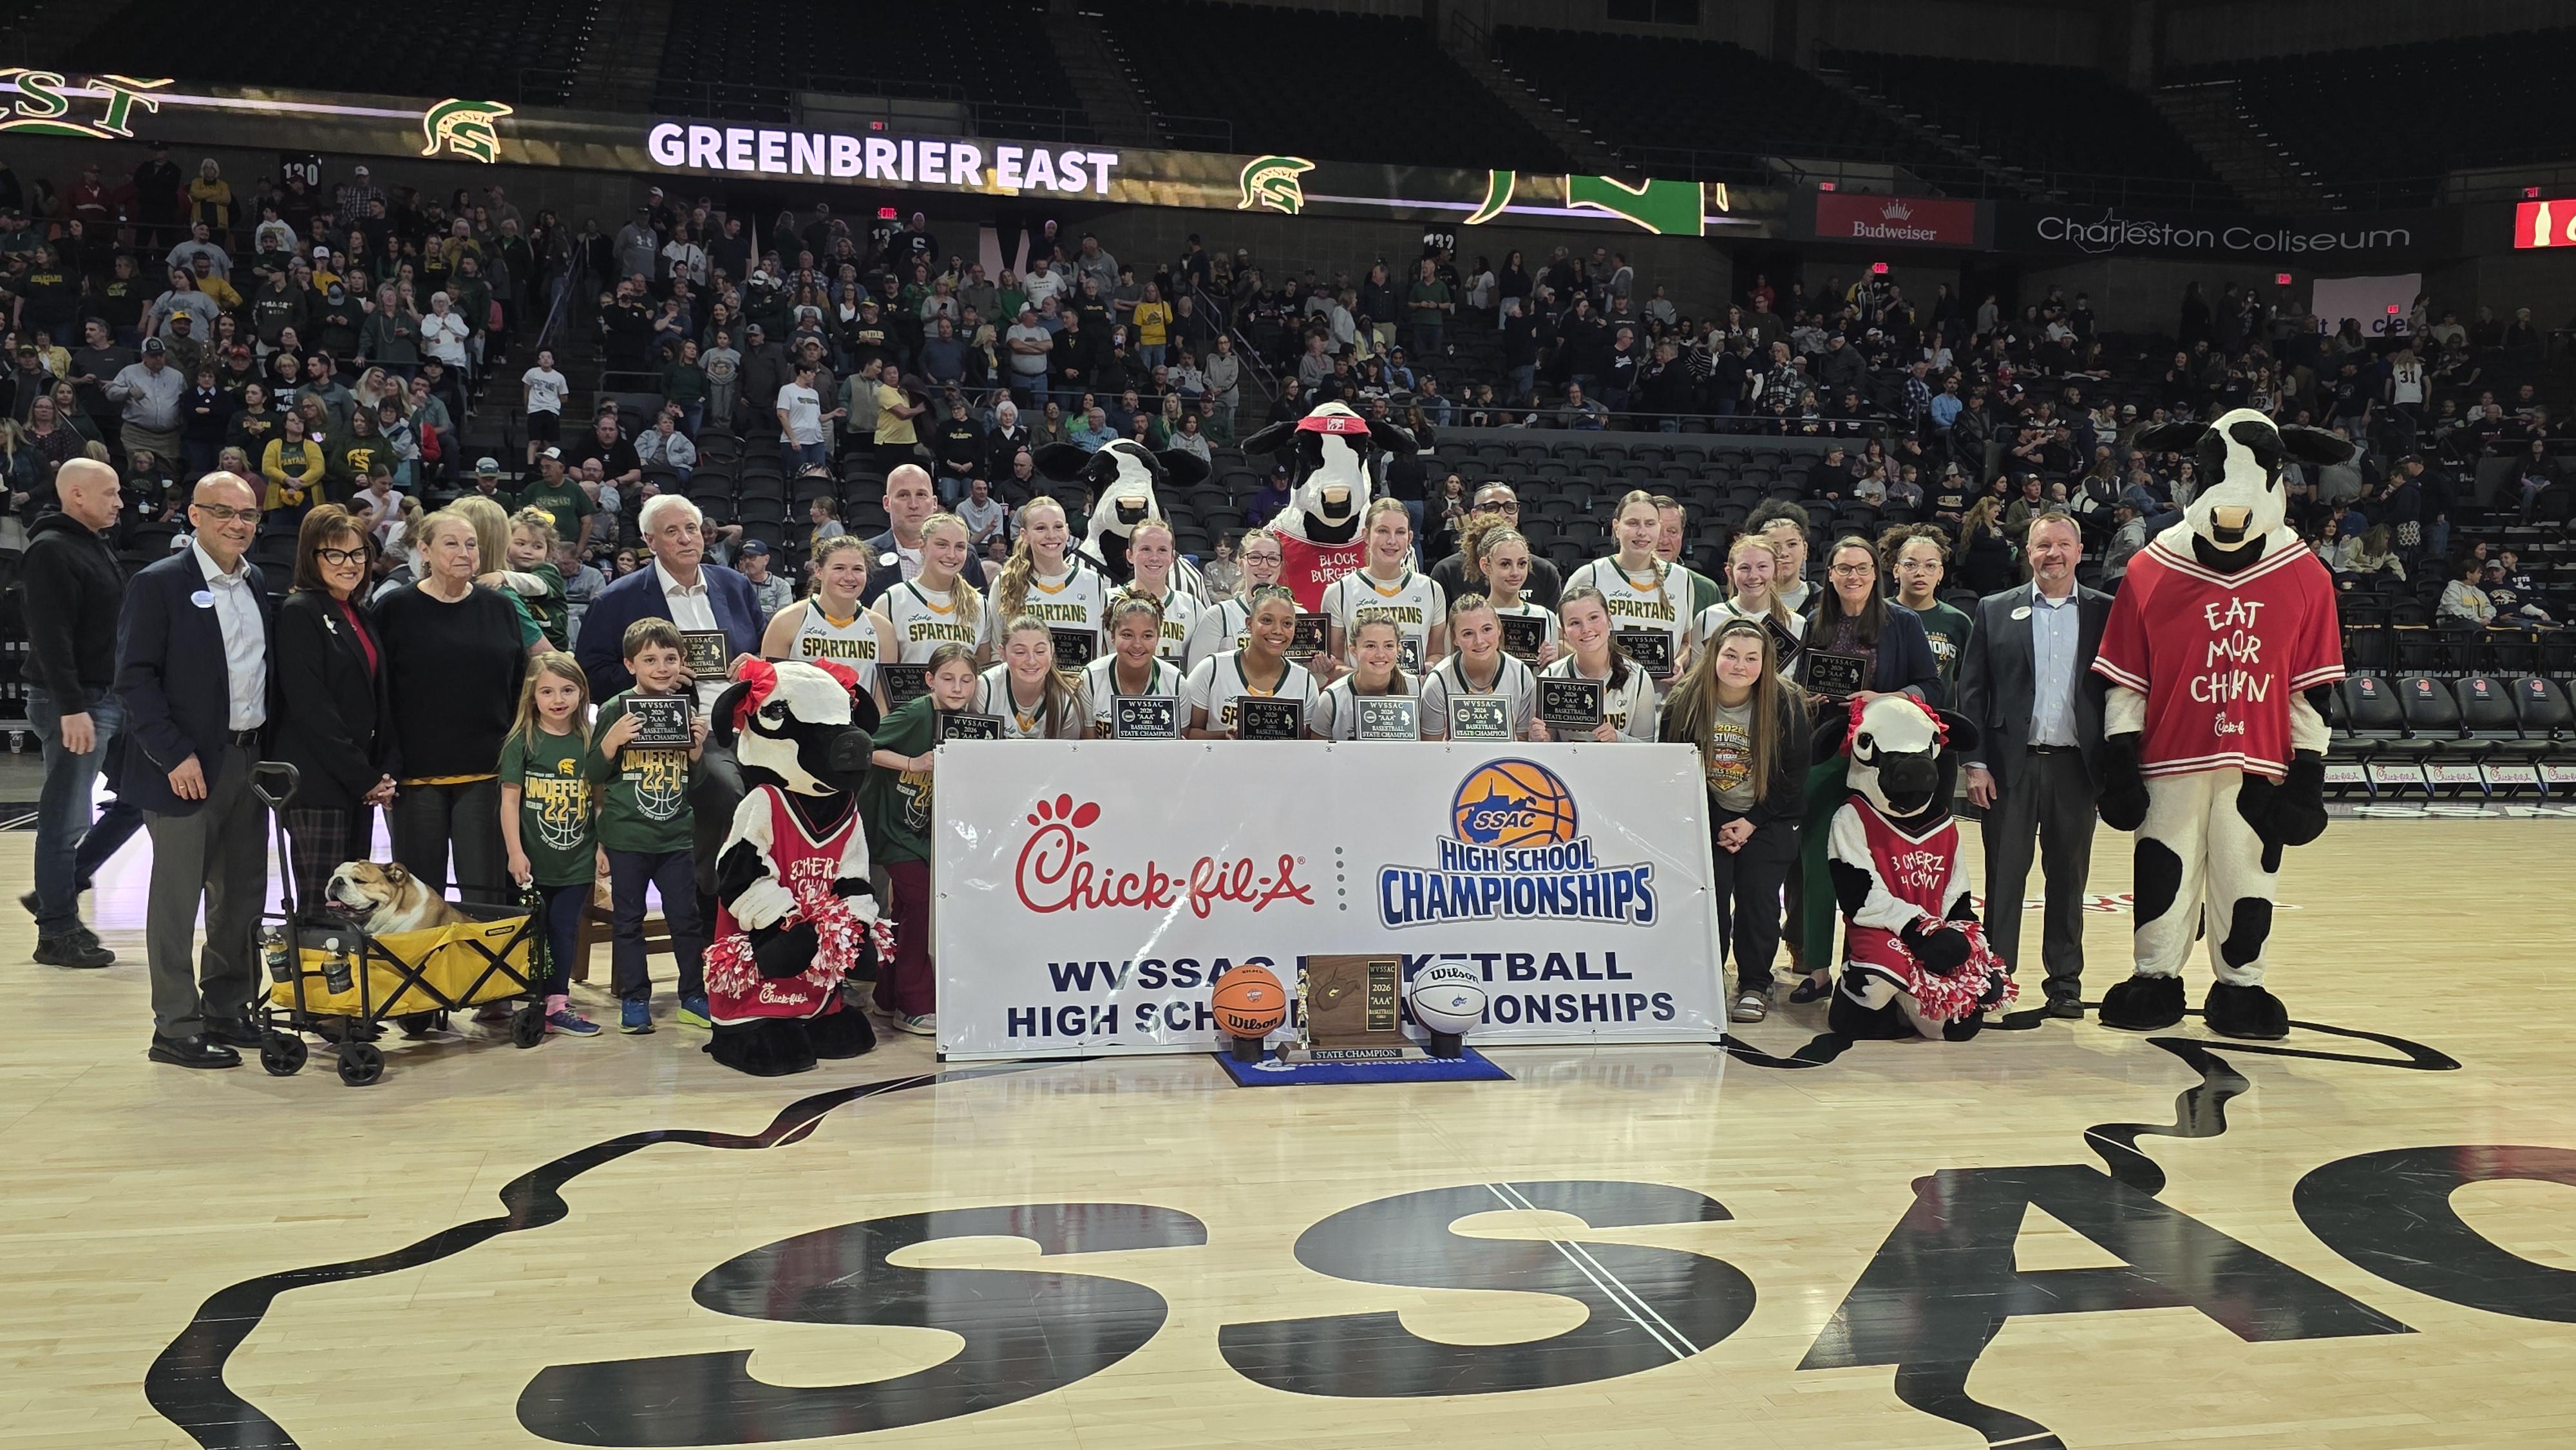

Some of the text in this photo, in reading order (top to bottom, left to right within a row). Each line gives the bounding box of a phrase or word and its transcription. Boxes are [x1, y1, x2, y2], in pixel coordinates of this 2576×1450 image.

[649, 123, 1118, 194] GREENBRIER EAST
[283, 163, 318, 185] 130
[1852, 221, 1937, 241] Budweiser
[2038, 215, 2410, 253] Charleston Coliseum
[2400, 370, 2416, 384] 31
[1319, 552, 1359, 567] BLOCK
[1025, 594, 1041, 603] ady
[1356, 598, 1378, 607] Lady
[1609, 589, 1633, 598] Lady
[909, 614, 933, 622] Lady
[1609, 599, 1676, 623] SPARTANS
[2204, 597, 2264, 631] EAT
[804, 626, 828, 636] Lady
[909, 623, 976, 646] SPARTANS
[1159, 621, 1186, 642] TANS
[802, 637, 876, 661] SPARTANS
[2206, 630, 2262, 668] MOR
[1821, 657, 1855, 666] WVSSAC
[1818, 680, 1852, 689] BASKETBALL
[1826, 686, 1855, 695] CHAMPIO
[1255, 704, 1289, 712] WVSSAC
[953, 718, 989, 728] WVSSAC
[1473, 811, 1537, 829] SSAC
[1439, 839, 1595, 871] HIGH SCHOOL
[1891, 849, 1945, 872] 3 CHERZ
[1016, 824, 1315, 919] Chick-fil-A
[1901, 874, 1910, 891] 4
[1381, 865, 1653, 925] CHAMPIONSHIPS
[1430, 966, 1481, 984] Wilson
[1370, 996, 1393, 1005] "AAA"
[1009, 1003, 1118, 1037] HIGH
[1228, 1013, 1278, 1030] Wilson
[1316, 1050, 1397, 1059] STATE CHAMPION
